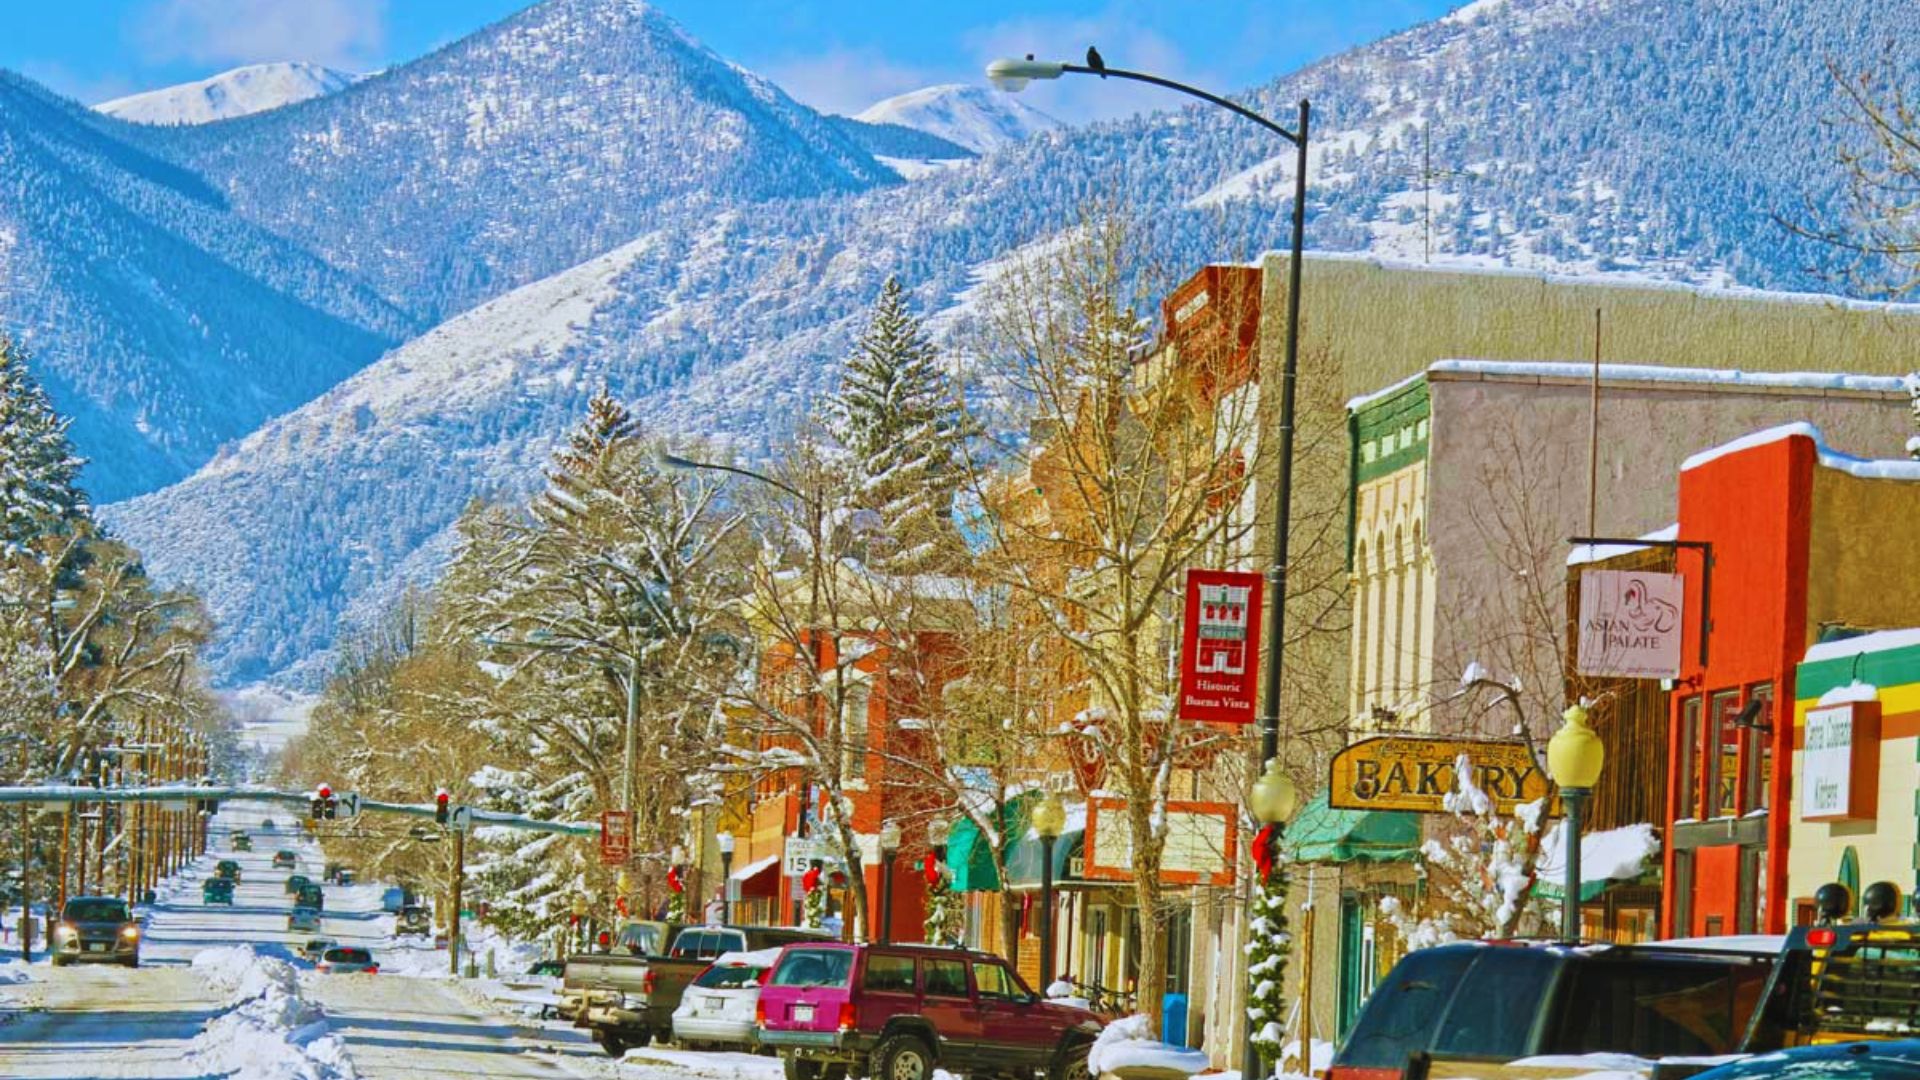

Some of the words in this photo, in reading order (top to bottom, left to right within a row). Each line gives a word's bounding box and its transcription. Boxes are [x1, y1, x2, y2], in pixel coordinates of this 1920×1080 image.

[1586, 617, 1630, 634] ASIAN
[1609, 635, 1661, 649] PALATE
[1196, 680, 1241, 693] Historic
[1185, 695, 1220, 707] Buena
[1223, 697, 1250, 709] Vista
[790, 857, 807, 872] 15
